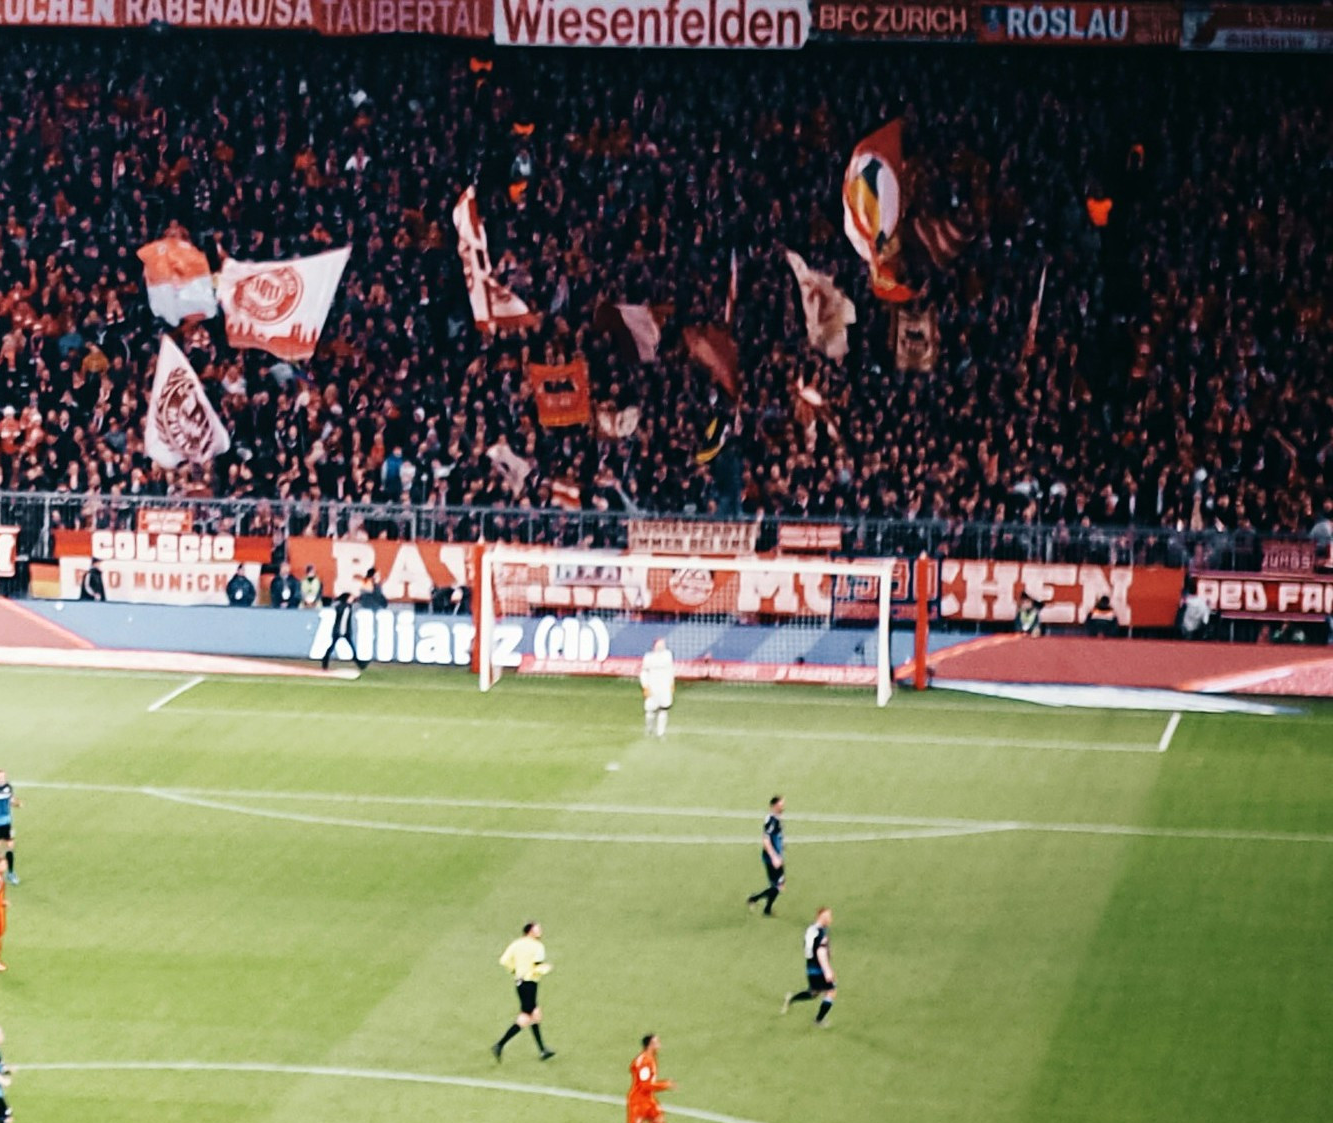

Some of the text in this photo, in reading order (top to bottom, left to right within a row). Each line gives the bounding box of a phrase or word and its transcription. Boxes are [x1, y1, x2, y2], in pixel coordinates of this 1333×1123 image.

[323, 0, 490, 34] TAUBERTAL
[501, 0, 802, 47] Wiesenfelden
[819, 5, 868, 30] BFC
[1007, 4, 1130, 41] RÖSLAU
[74, 568, 121, 590] RD
[1196, 579, 1267, 611] RED
